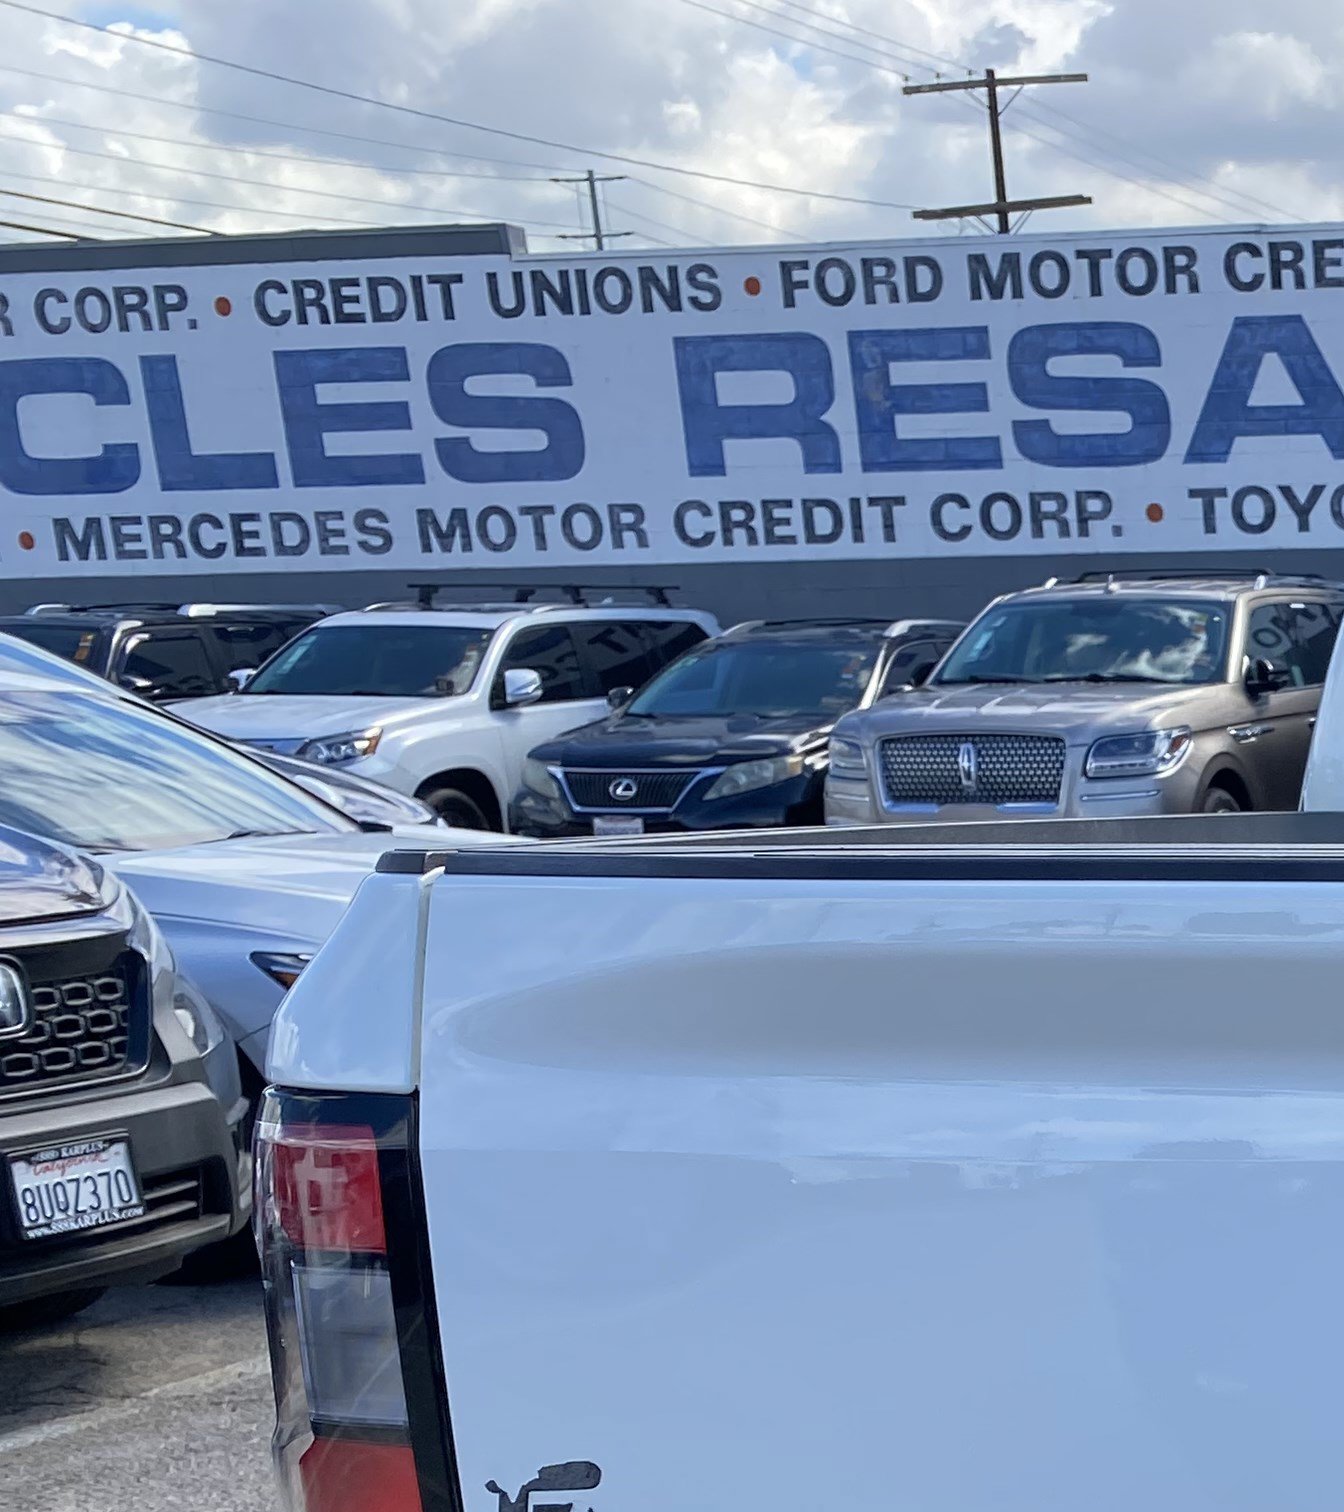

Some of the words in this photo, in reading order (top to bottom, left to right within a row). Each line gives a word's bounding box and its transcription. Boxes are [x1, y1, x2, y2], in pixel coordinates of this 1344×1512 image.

[34, 284, 197, 335] CORP.
[254, 273, 463, 326] CREDIT
[486, 264, 722, 318] UNIONS
[779, 255, 943, 308] FORD
[968, 246, 1199, 300] MOTOR
[0, 342, 585, 495] CLES
[52, 509, 393, 562] MERCEDES
[416, 503, 649, 554] MOTOR
[674, 496, 906, 548] CREDIT
[930, 490, 1123, 543] CORP.
